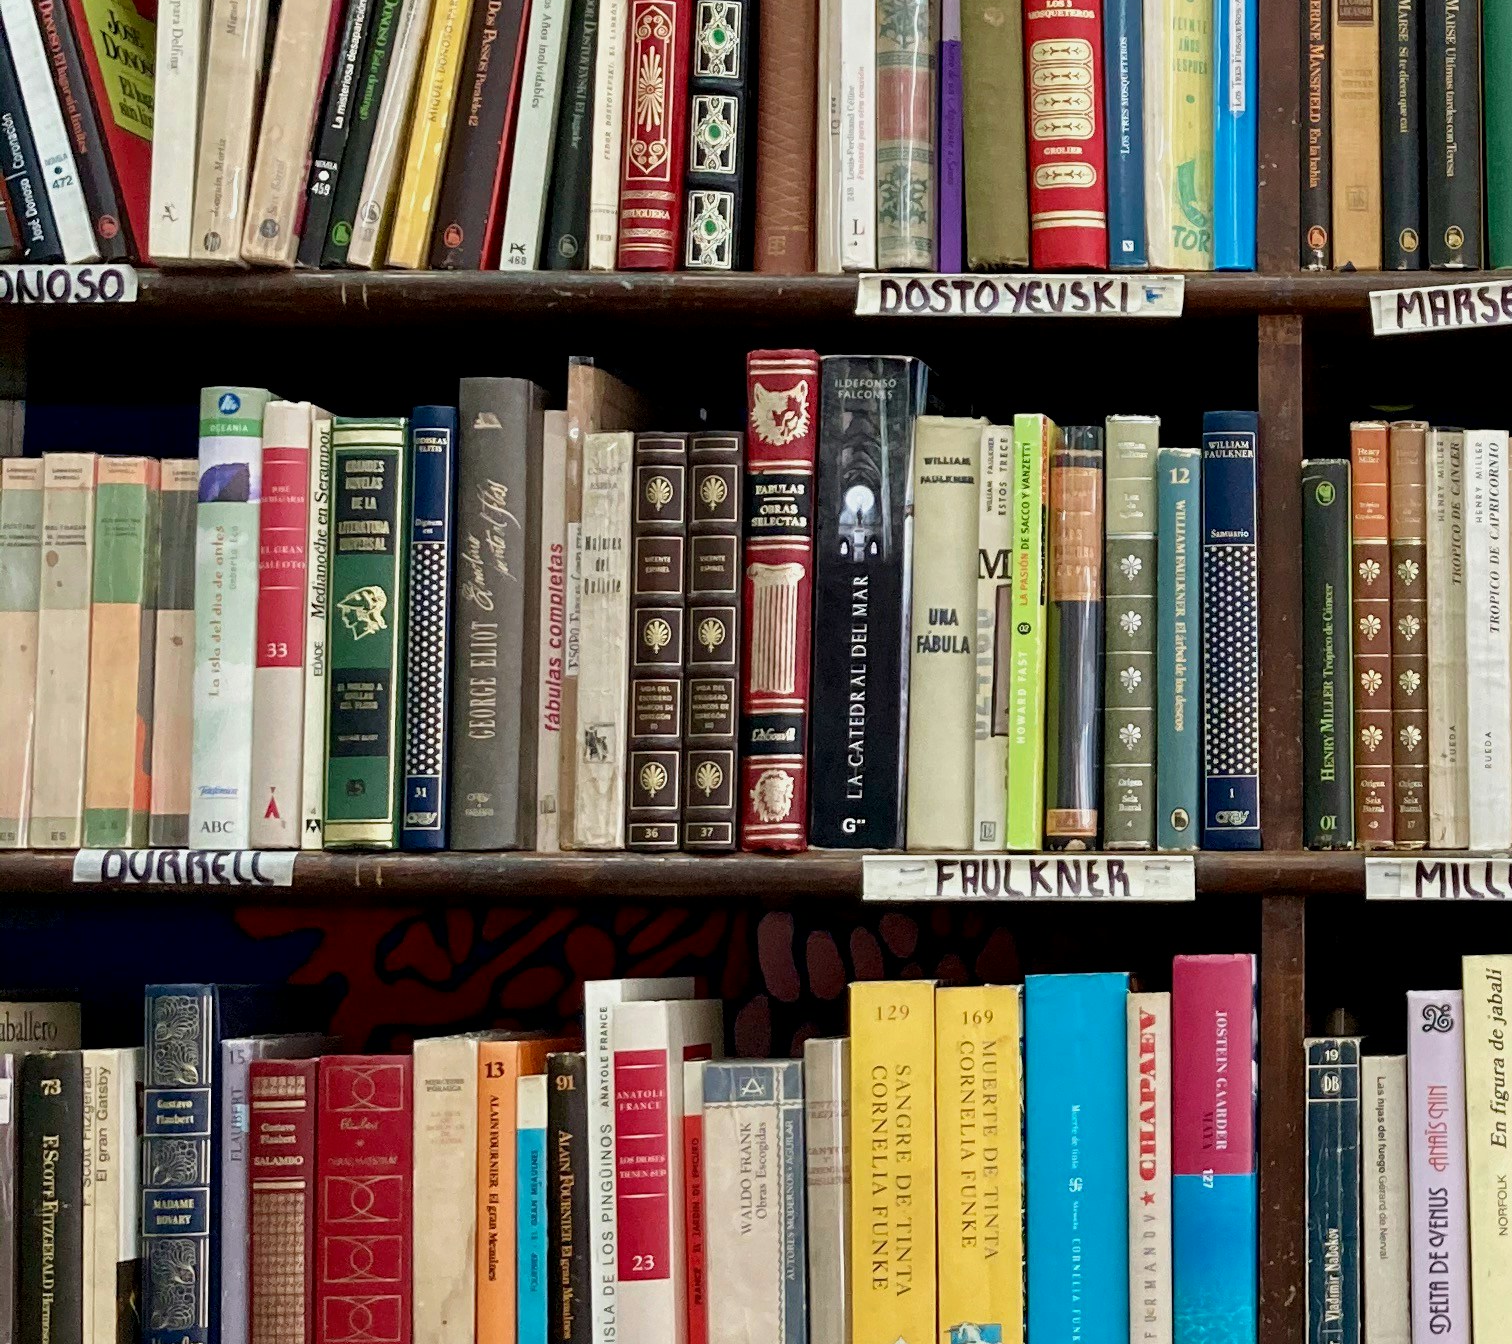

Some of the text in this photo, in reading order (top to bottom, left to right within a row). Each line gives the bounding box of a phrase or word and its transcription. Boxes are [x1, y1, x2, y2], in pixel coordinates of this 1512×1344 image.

[928, 607, 959, 627] UNA
[266, 643, 288, 658] 33
[543, 543, 564, 732] fábulas completas
[916, 631, 970, 654] FÁBULA
[468, 620, 498, 740] GEORGE ELIOT
[846, 574, 869, 799] LA CATEDRAL DEL MAR
[201, 819, 234, 834] ABC
[101, 850, 273, 885] DURRELL
[937, 859, 1131, 897] FAULKNER
[875, 1005, 909, 1021] 129
[962, 1009, 993, 1025] 169
[1491, 1029, 1504, 1053] de
[484, 1061, 505, 1080] 13
[555, 1075, 575, 1092] 91
[1138, 1006, 1156, 1180] CHAPAEV
[1489, 1057, 1509, 1116] figura
[959, 1038, 977, 1248] CORNELIA FUNKE
[981, 1038, 999, 1260] MUERTE DE TINTA
[1489, 1122, 1506, 1149] En
[871, 1064, 889, 1291] CORNELIA FUNKE
[895, 1064, 913, 1297] SANGRE DE TINTA
[632, 1255, 654, 1270] 23
